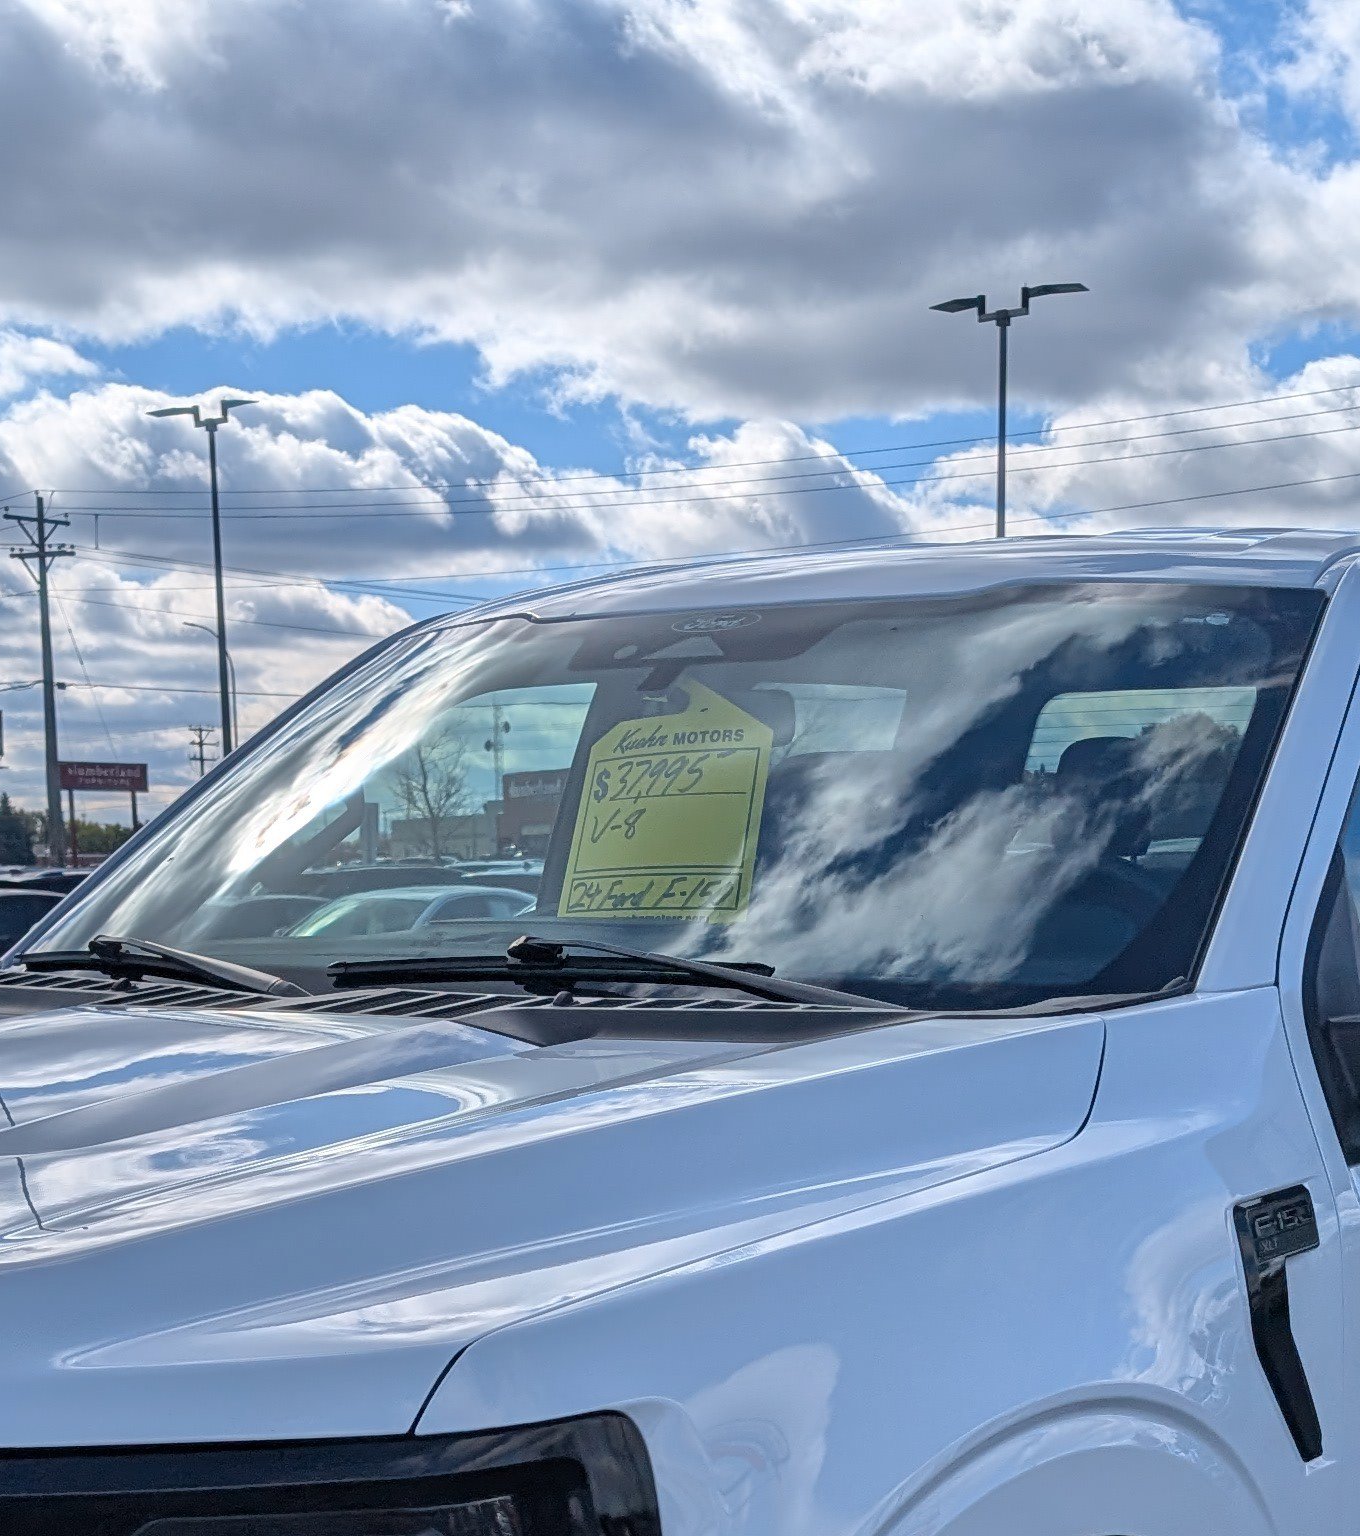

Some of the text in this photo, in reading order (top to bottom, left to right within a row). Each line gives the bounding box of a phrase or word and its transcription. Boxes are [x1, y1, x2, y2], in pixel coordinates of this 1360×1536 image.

[612, 724, 745, 754] Kuehn MOTORS
[590, 807, 647, 844] V-8
[597, 879, 655, 911] Ford
